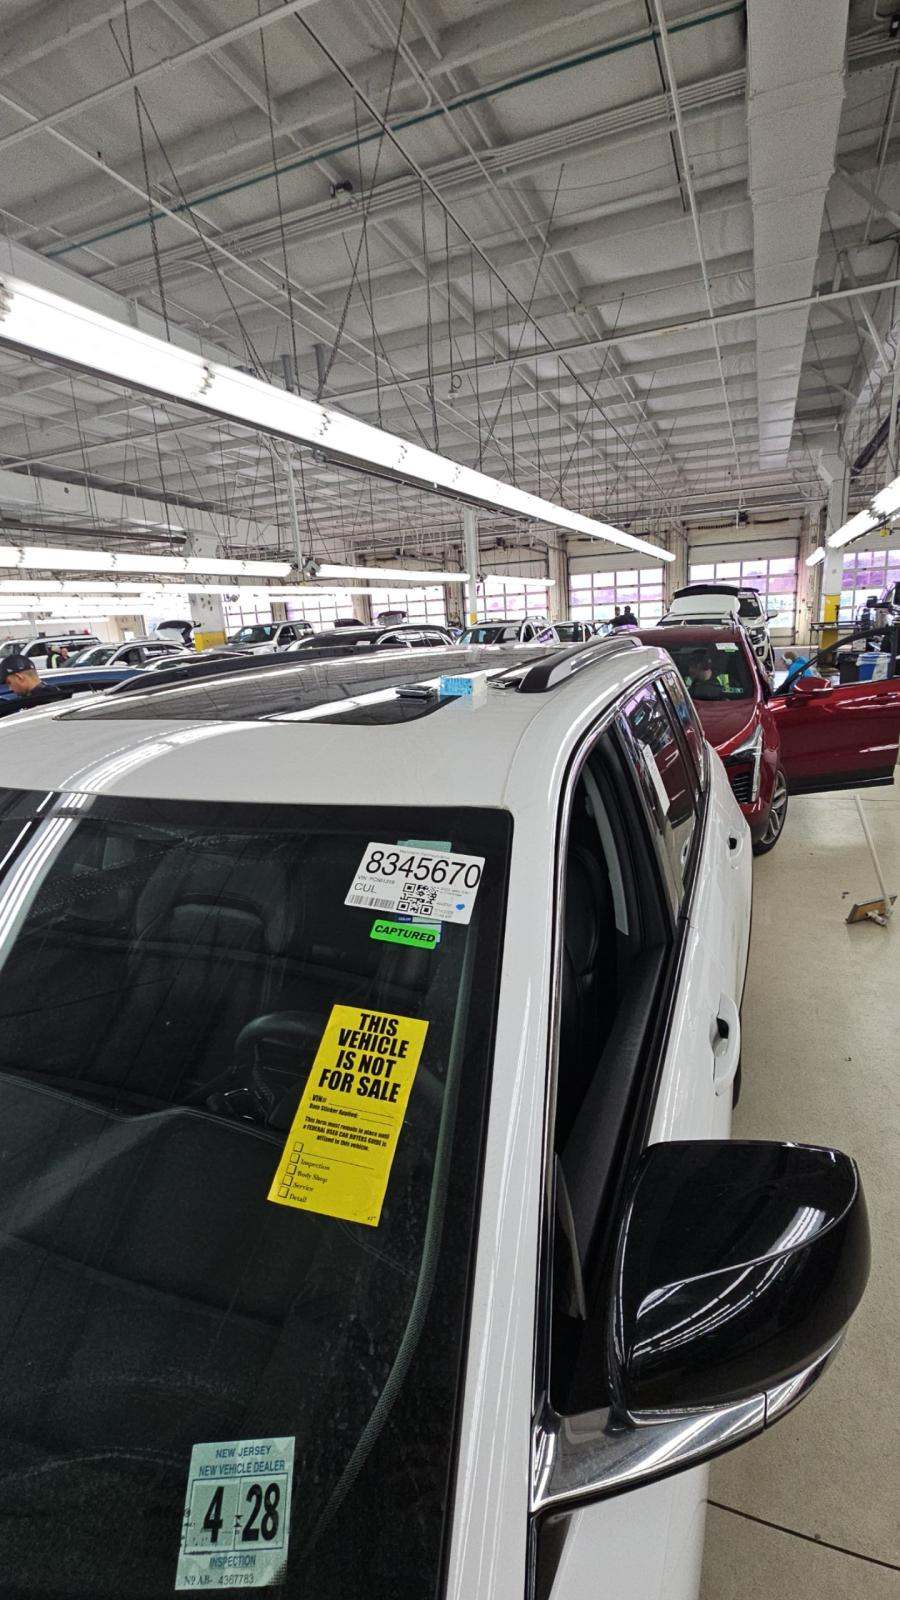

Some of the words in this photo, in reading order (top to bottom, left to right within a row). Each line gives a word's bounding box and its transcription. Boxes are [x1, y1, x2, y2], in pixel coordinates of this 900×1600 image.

[366, 850, 481, 888] 8345670
[354, 882, 377, 894] CUL
[374, 924, 436, 942] CAPTURED
[358, 1013, 399, 1037] THIS
[338, 1028, 409, 1059] VEHICLE
[335, 1049, 356, 1071] IS
[357, 1054, 397, 1078] NOT
[318, 1068, 355, 1093] FOR
[356, 1075, 401, 1103] SALE
[320, 1105, 338, 1114] Sticker
[306, 1124, 326, 1134] FEDERAL
[326, 1128, 339, 1136] USED
[339, 1131, 349, 1139] CAR
[367, 1137, 382, 1146] GUIDE
[327, 1121, 340, 1129] must
[363, 1129, 377, 1137] place
[300, 1159, 330, 1171] Inspection
[297, 1170, 311, 1180] Body
[312, 1173, 328, 1184] Shop
[293, 1182, 314, 1192] Service
[289, 1193, 307, 1203] Detail
[215, 1448, 236, 1459] NEW
[238, 1445, 272, 1457] JERSEY
[199, 1465, 218, 1477] NEW
[219, 1462, 251, 1475] VEHICLE
[253, 1460, 286, 1472] DEALER
[202, 1486, 225, 1543] 4
[241, 1482, 281, 1542] 28
[209, 1554, 257, 1568] INSPECTION
